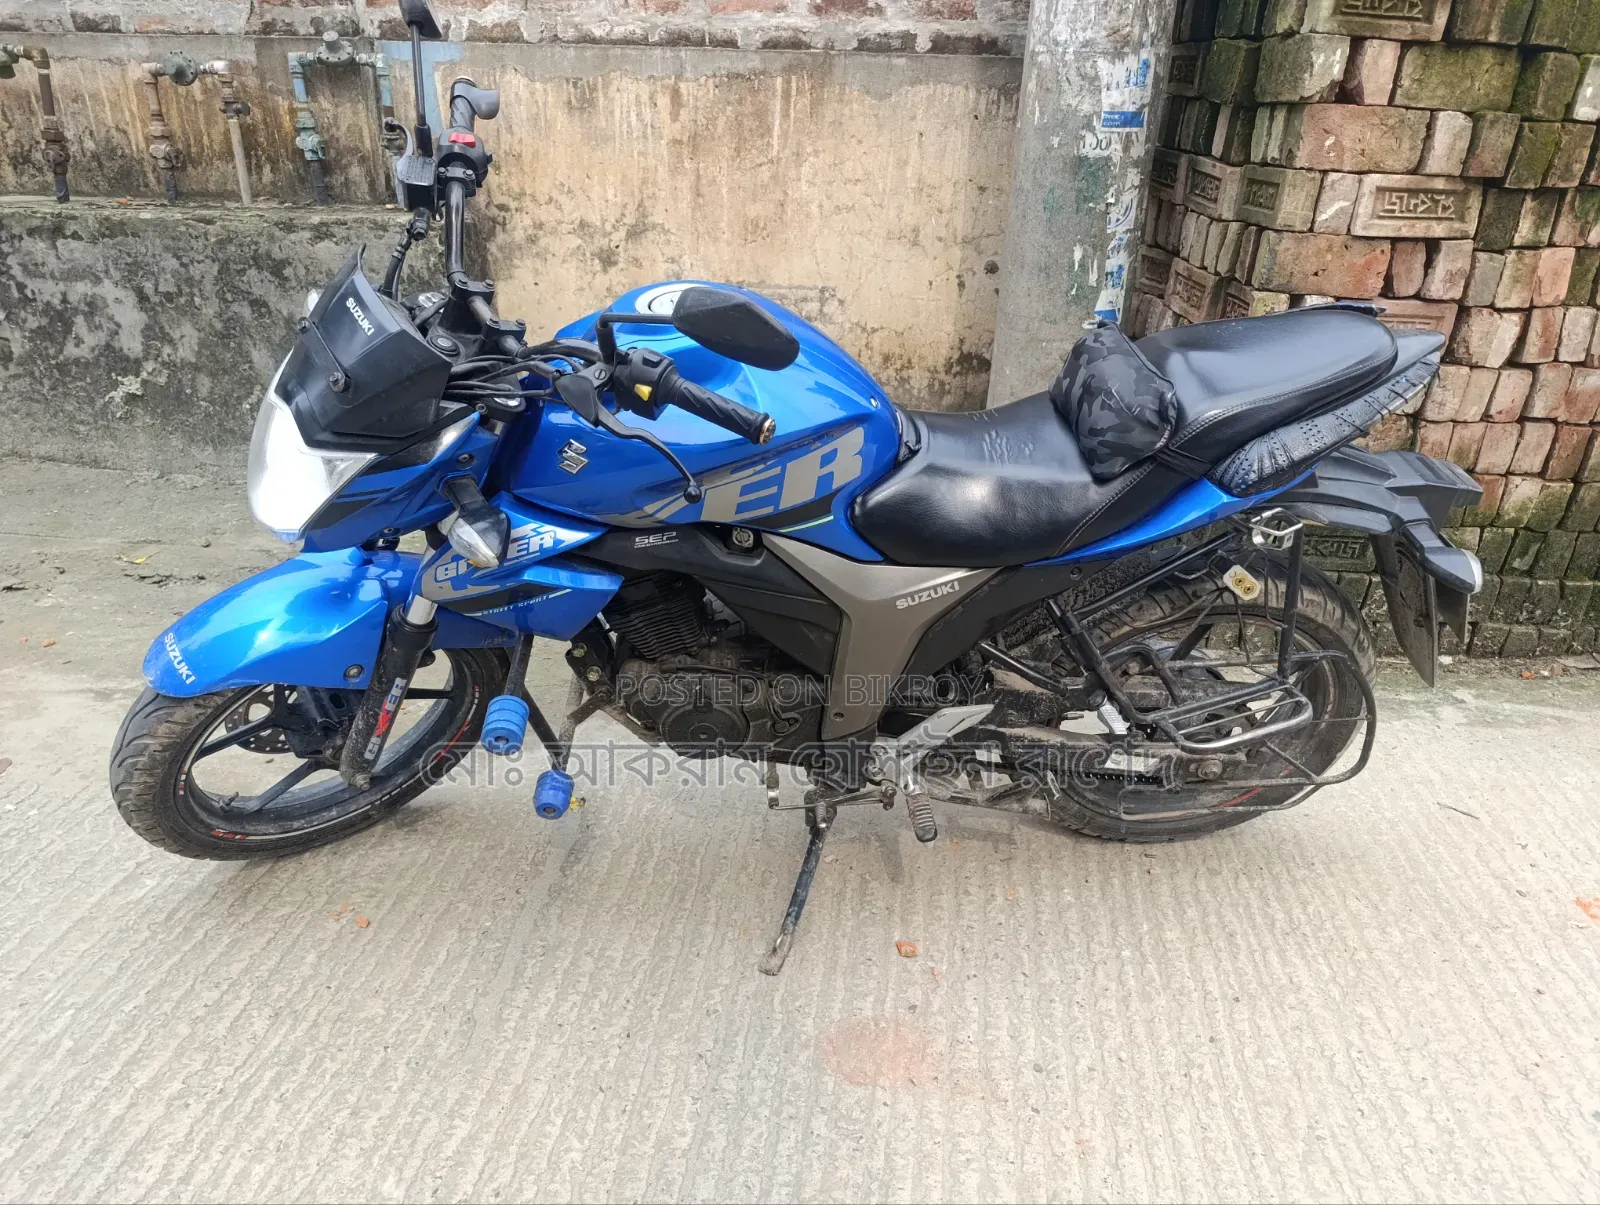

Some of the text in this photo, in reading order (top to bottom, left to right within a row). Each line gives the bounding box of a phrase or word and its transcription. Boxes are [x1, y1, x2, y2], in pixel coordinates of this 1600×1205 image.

[346, 297, 375, 336] SUZUKI
[635, 531, 678, 546] SEP
[895, 581, 960, 609] SUZUKI
[165, 632, 196, 685] SUZUKI
